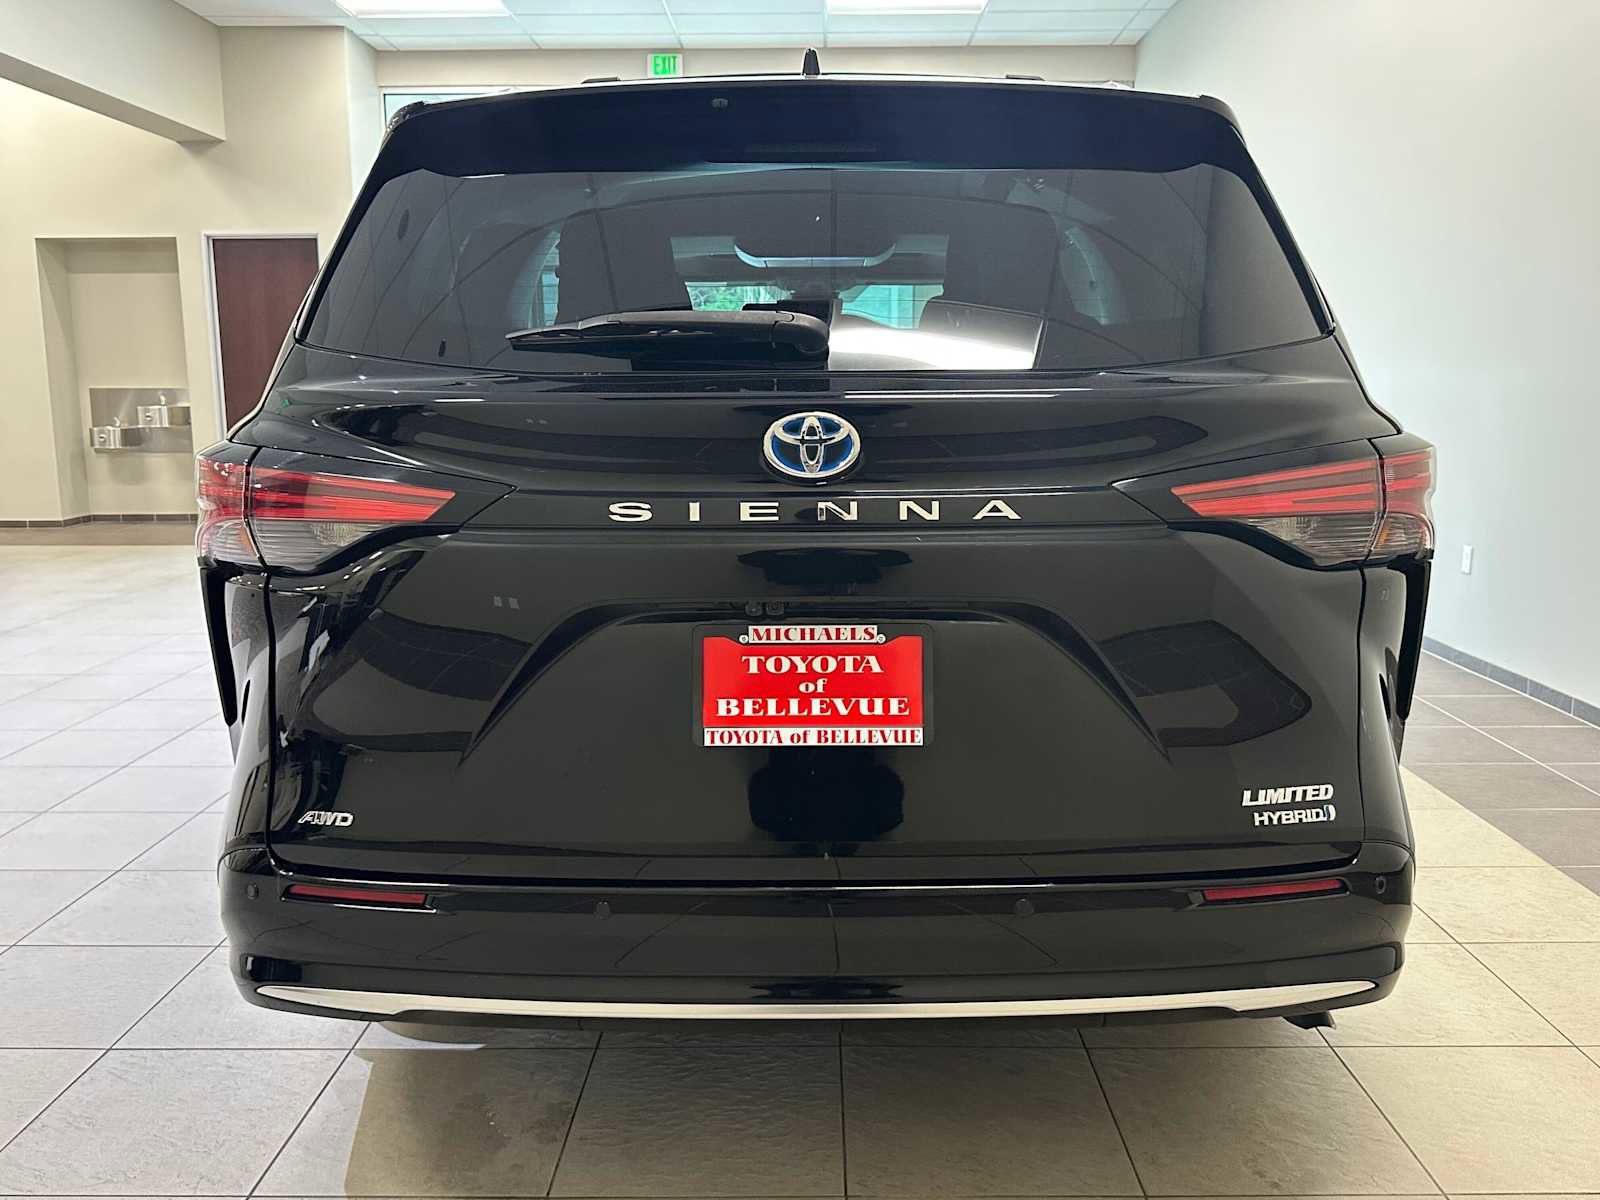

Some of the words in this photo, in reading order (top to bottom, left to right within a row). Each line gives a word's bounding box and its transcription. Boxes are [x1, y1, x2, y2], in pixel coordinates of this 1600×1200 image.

[653, 55, 677, 75] EXIT
[607, 500, 1022, 522] SIENNA
[751, 627, 876, 642] MICHAELS
[741, 655, 884, 674] TOYOTA
[798, 678, 828, 693] of
[716, 697, 910, 717] BELLEVUE
[706, 729, 783, 745] TOYOTA
[790, 729, 810, 745] of
[816, 729, 922, 745] BELLEVUE
[1241, 784, 1334, 807] LIMITED
[297, 810, 354, 827] AWD
[1253, 808, 1326, 826] HYBRID
